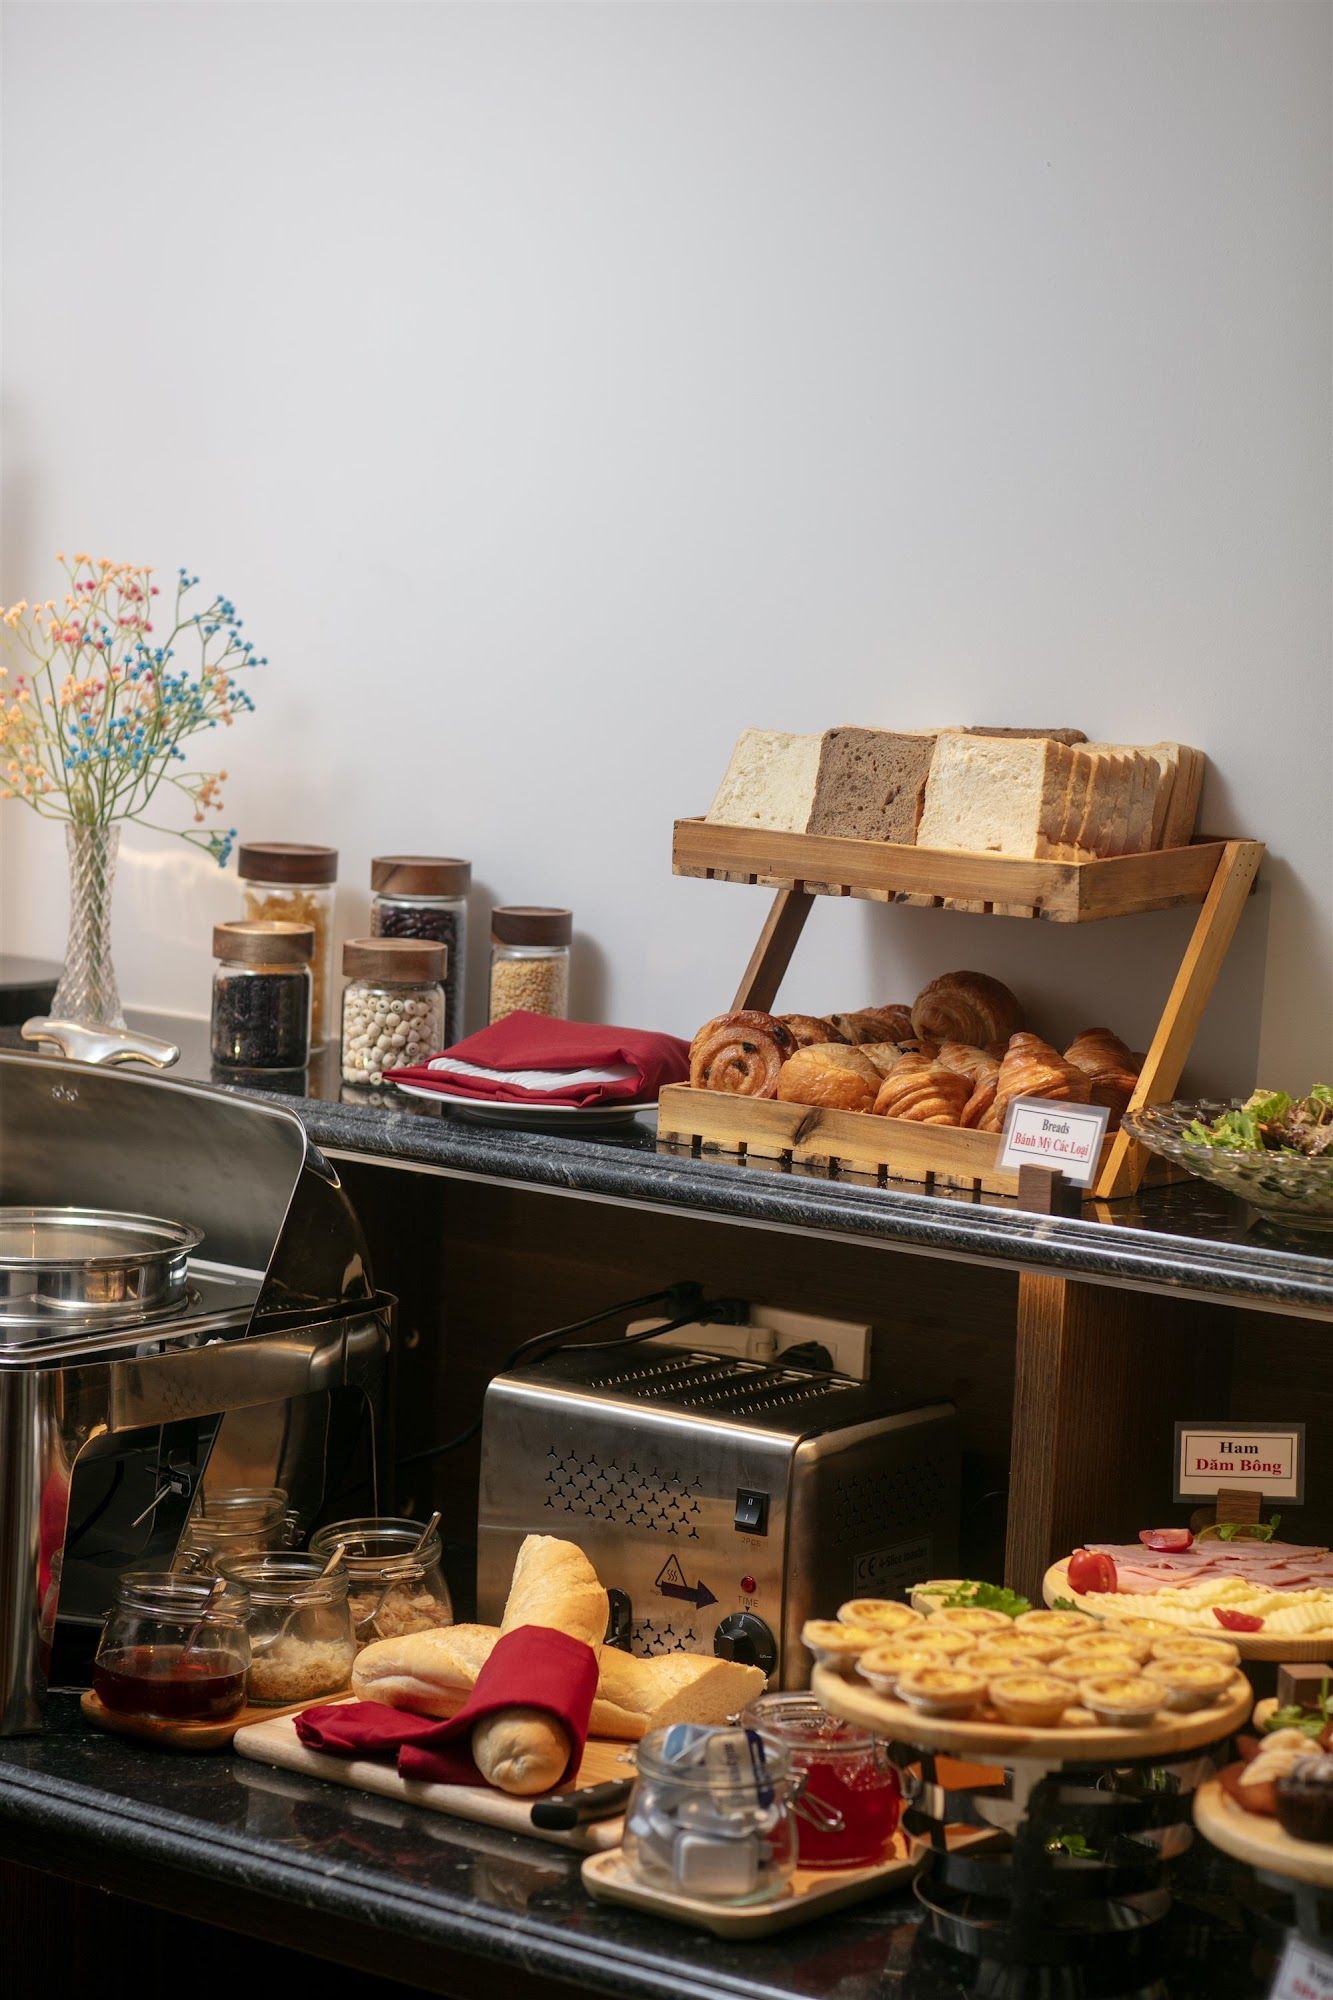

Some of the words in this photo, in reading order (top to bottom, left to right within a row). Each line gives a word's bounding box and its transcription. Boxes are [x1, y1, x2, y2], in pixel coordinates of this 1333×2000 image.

[1042, 1119, 1070, 1134] Breads
[1014, 1132, 1036, 1147] Bánh
[1053, 1138, 1069, 1152] Các
[1070, 1141, 1090, 1158] Loại
[1219, 1441, 1259, 1454] Ham
[1196, 1457, 1234, 1471] Dăm
[1240, 1459, 1282, 1476] Bông
[736, 1595, 759, 1608] TIME
